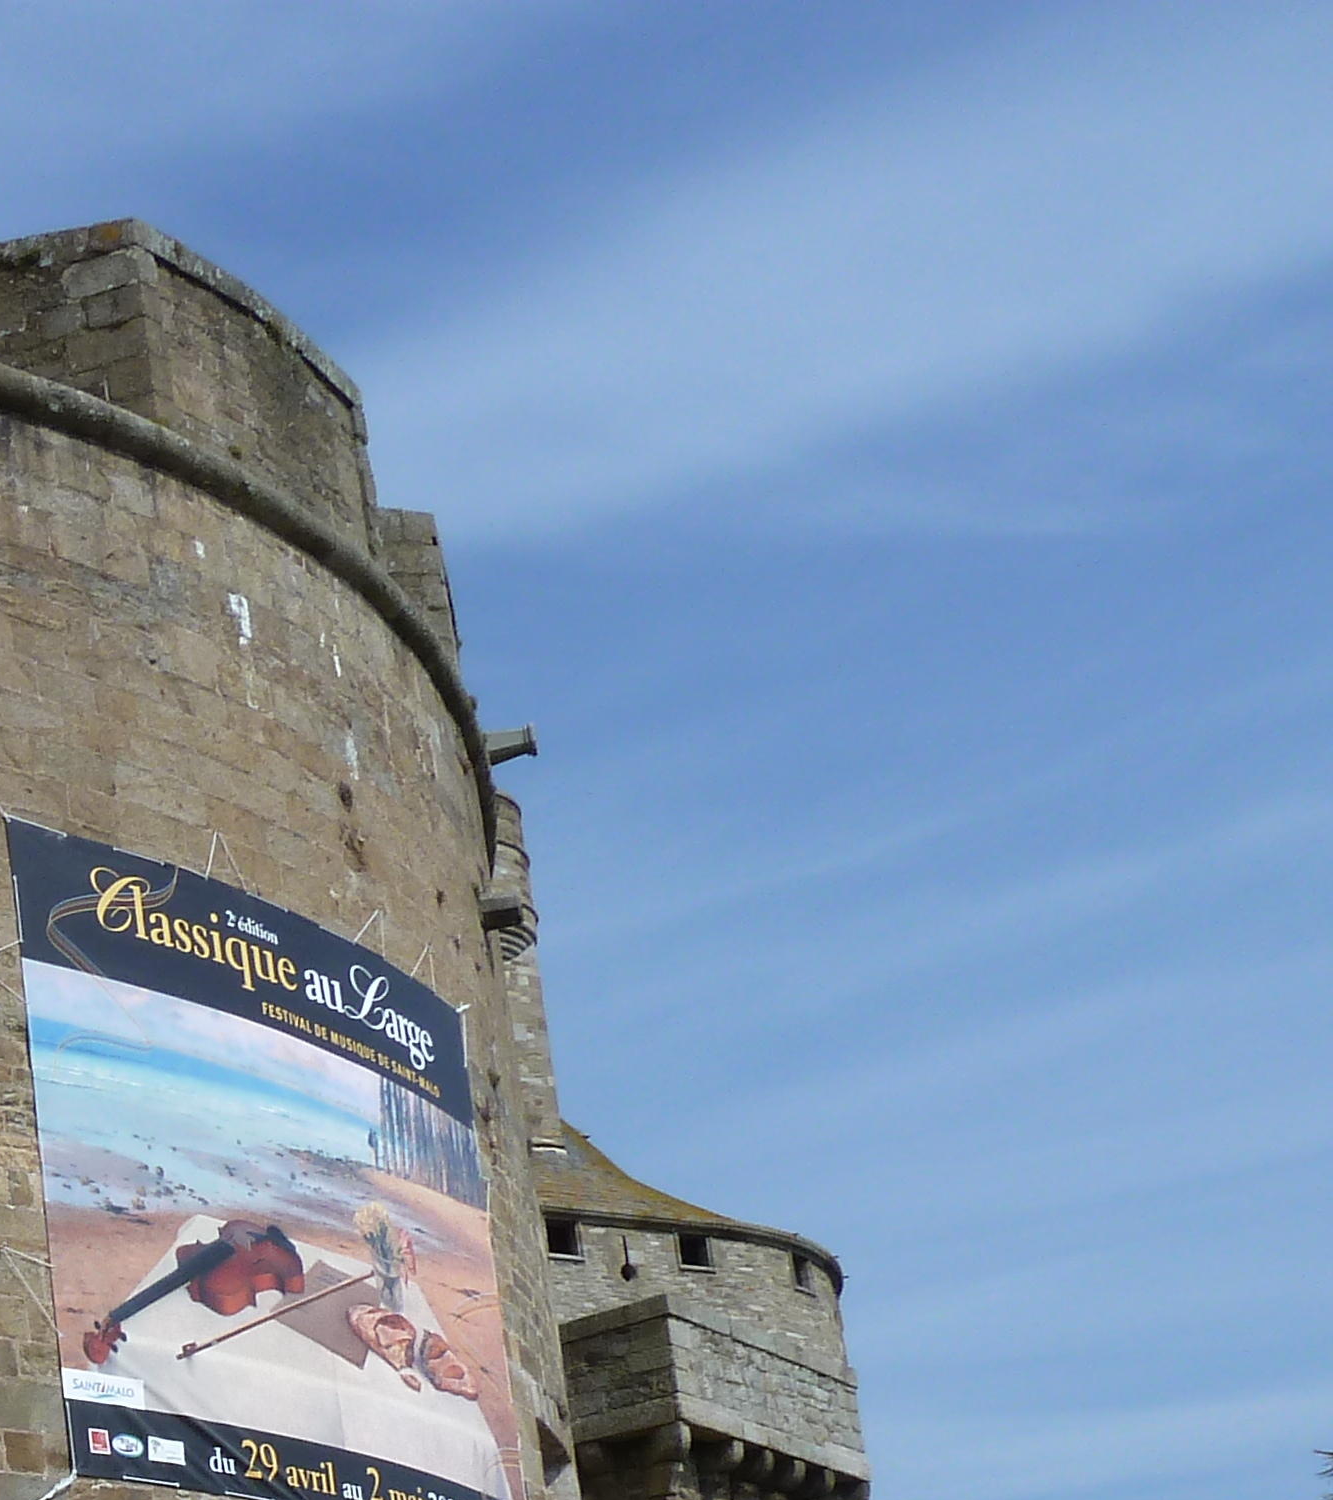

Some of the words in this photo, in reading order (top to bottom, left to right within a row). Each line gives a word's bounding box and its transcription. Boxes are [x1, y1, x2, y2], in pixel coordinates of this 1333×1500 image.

[237, 915, 279, 945] édition
[90, 866, 298, 991] Classique
[304, 969, 345, 1014] au
[344, 964, 435, 1071] Large
[262, 1002, 312, 1034] FESTIVAL
[314, 1024, 329, 1041] DE
[331, 1030, 376, 1062] MUSIQUE
[378, 1053, 390, 1069] DE
[391, 1061, 441, 1098] SAINT-MALO
[209, 1447, 236, 1475] du
[241, 1439, 279, 1482] 29
[286, 1461, 338, 1496] avril
